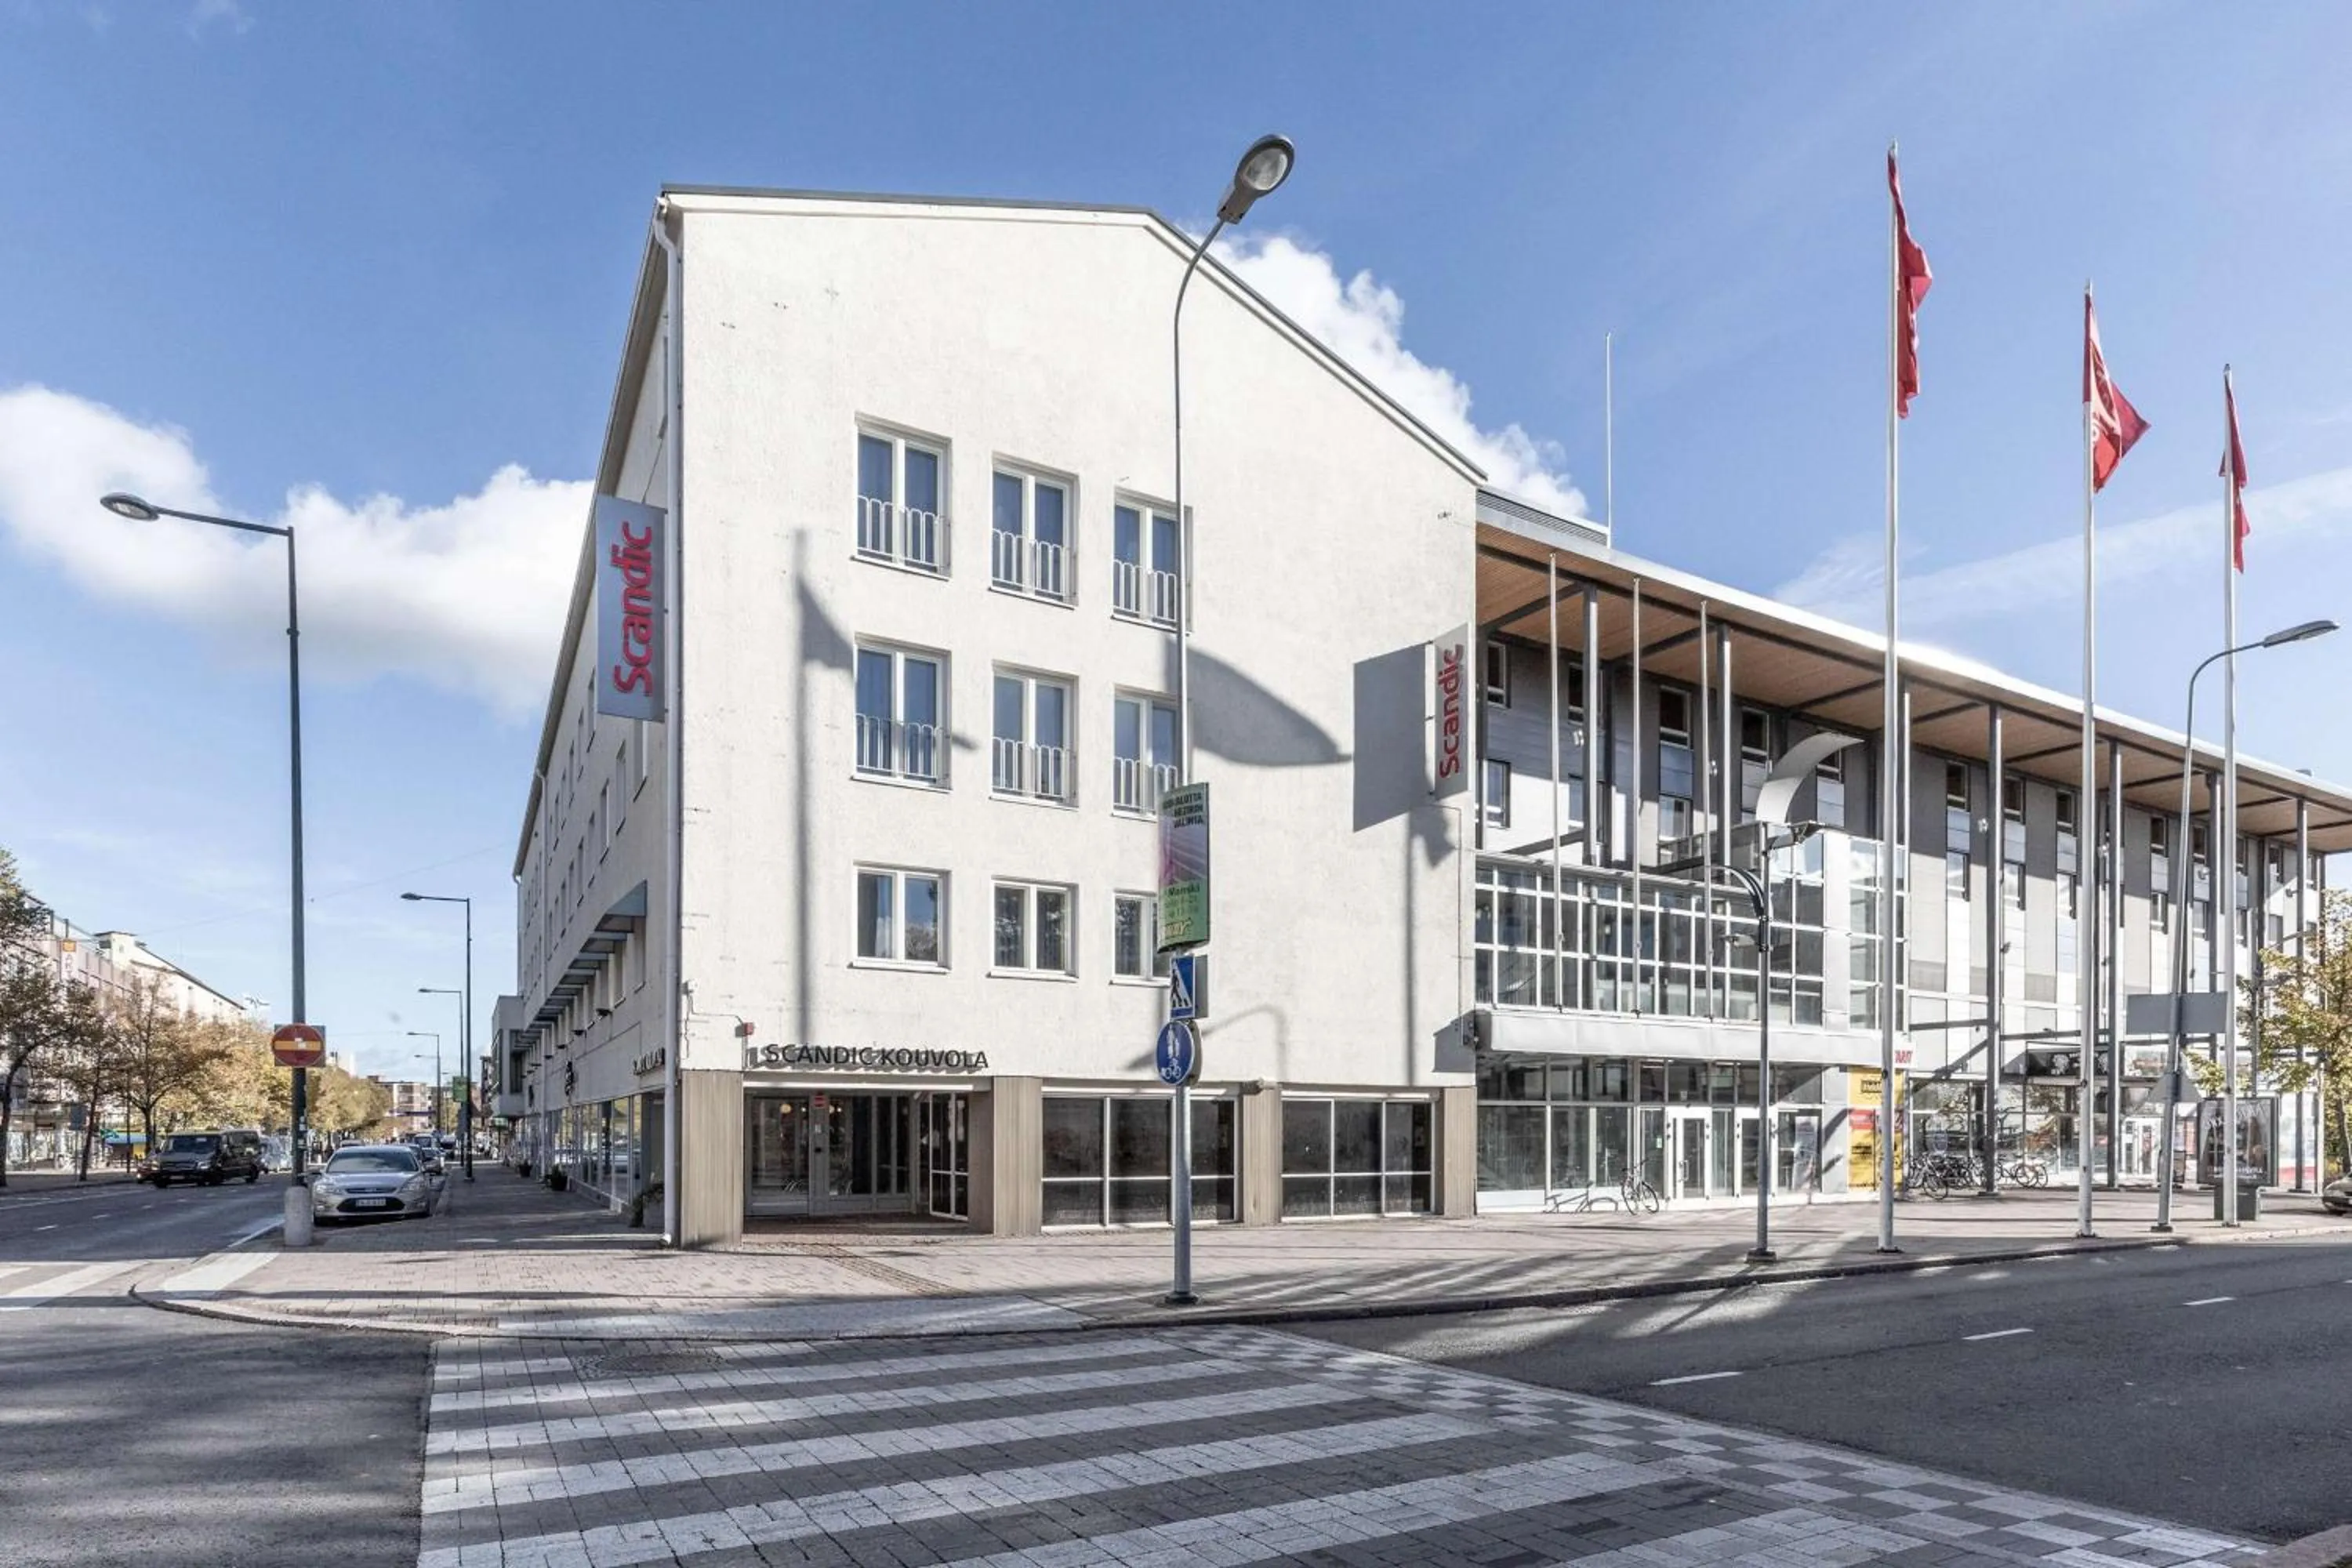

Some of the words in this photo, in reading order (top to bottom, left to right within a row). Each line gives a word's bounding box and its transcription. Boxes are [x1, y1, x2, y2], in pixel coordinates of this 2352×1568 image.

[609, 521, 653, 697] Scandic
[1438, 644, 1462, 778] Scandic
[765, 1043, 873, 1065] SCANDIC
[880, 1047, 989, 1069] KOUVOLA
